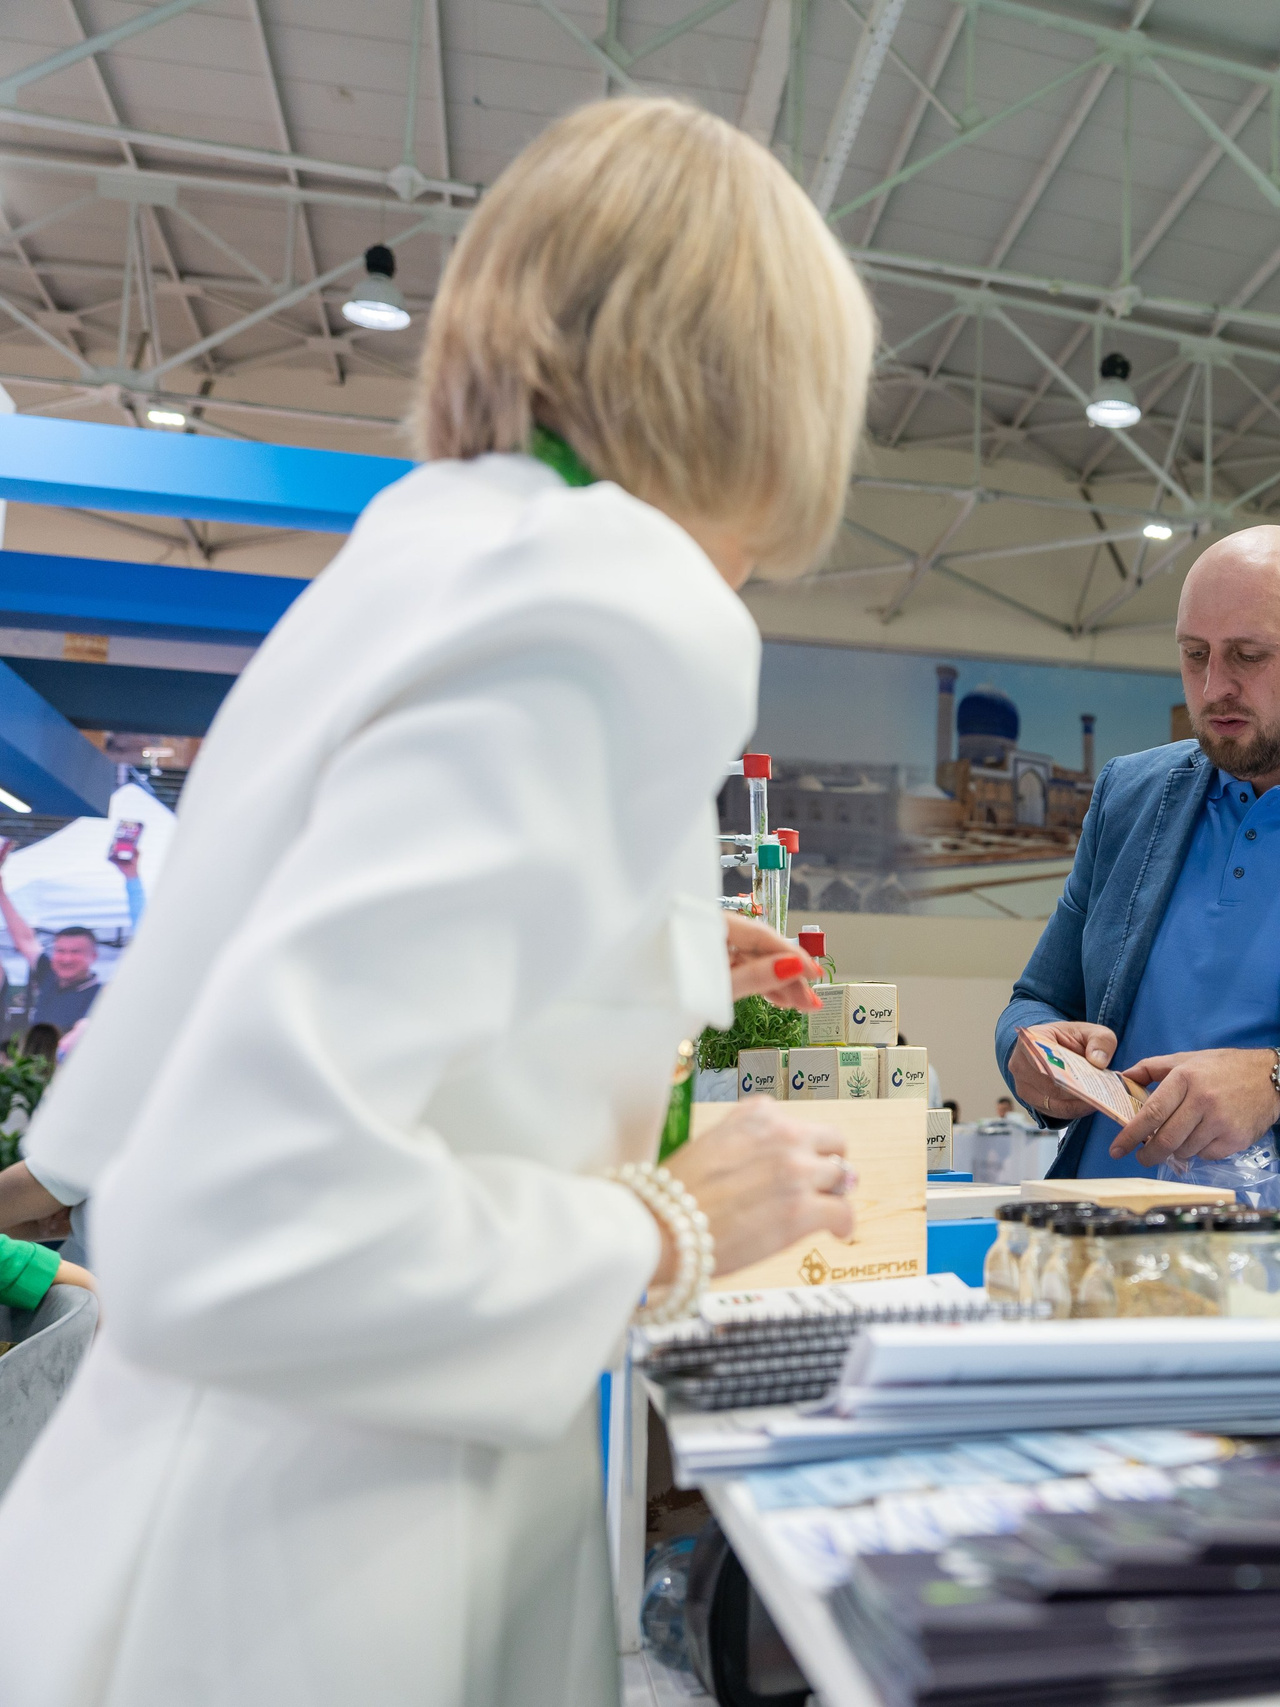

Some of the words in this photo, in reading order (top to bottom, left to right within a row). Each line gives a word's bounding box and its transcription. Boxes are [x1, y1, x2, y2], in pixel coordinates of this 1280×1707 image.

[869, 1009, 893, 1019] СурГУ
[842, 1052, 860, 1062] СОСНА
[755, 1075, 775, 1086] СурГУ
[807, 1073, 830, 1084] СурГУ
[905, 1071, 925, 1081] СурГУ
[926, 1135, 947, 1145] урГУ
[831, 1259, 919, 1280] СИНЕРГИЯ
